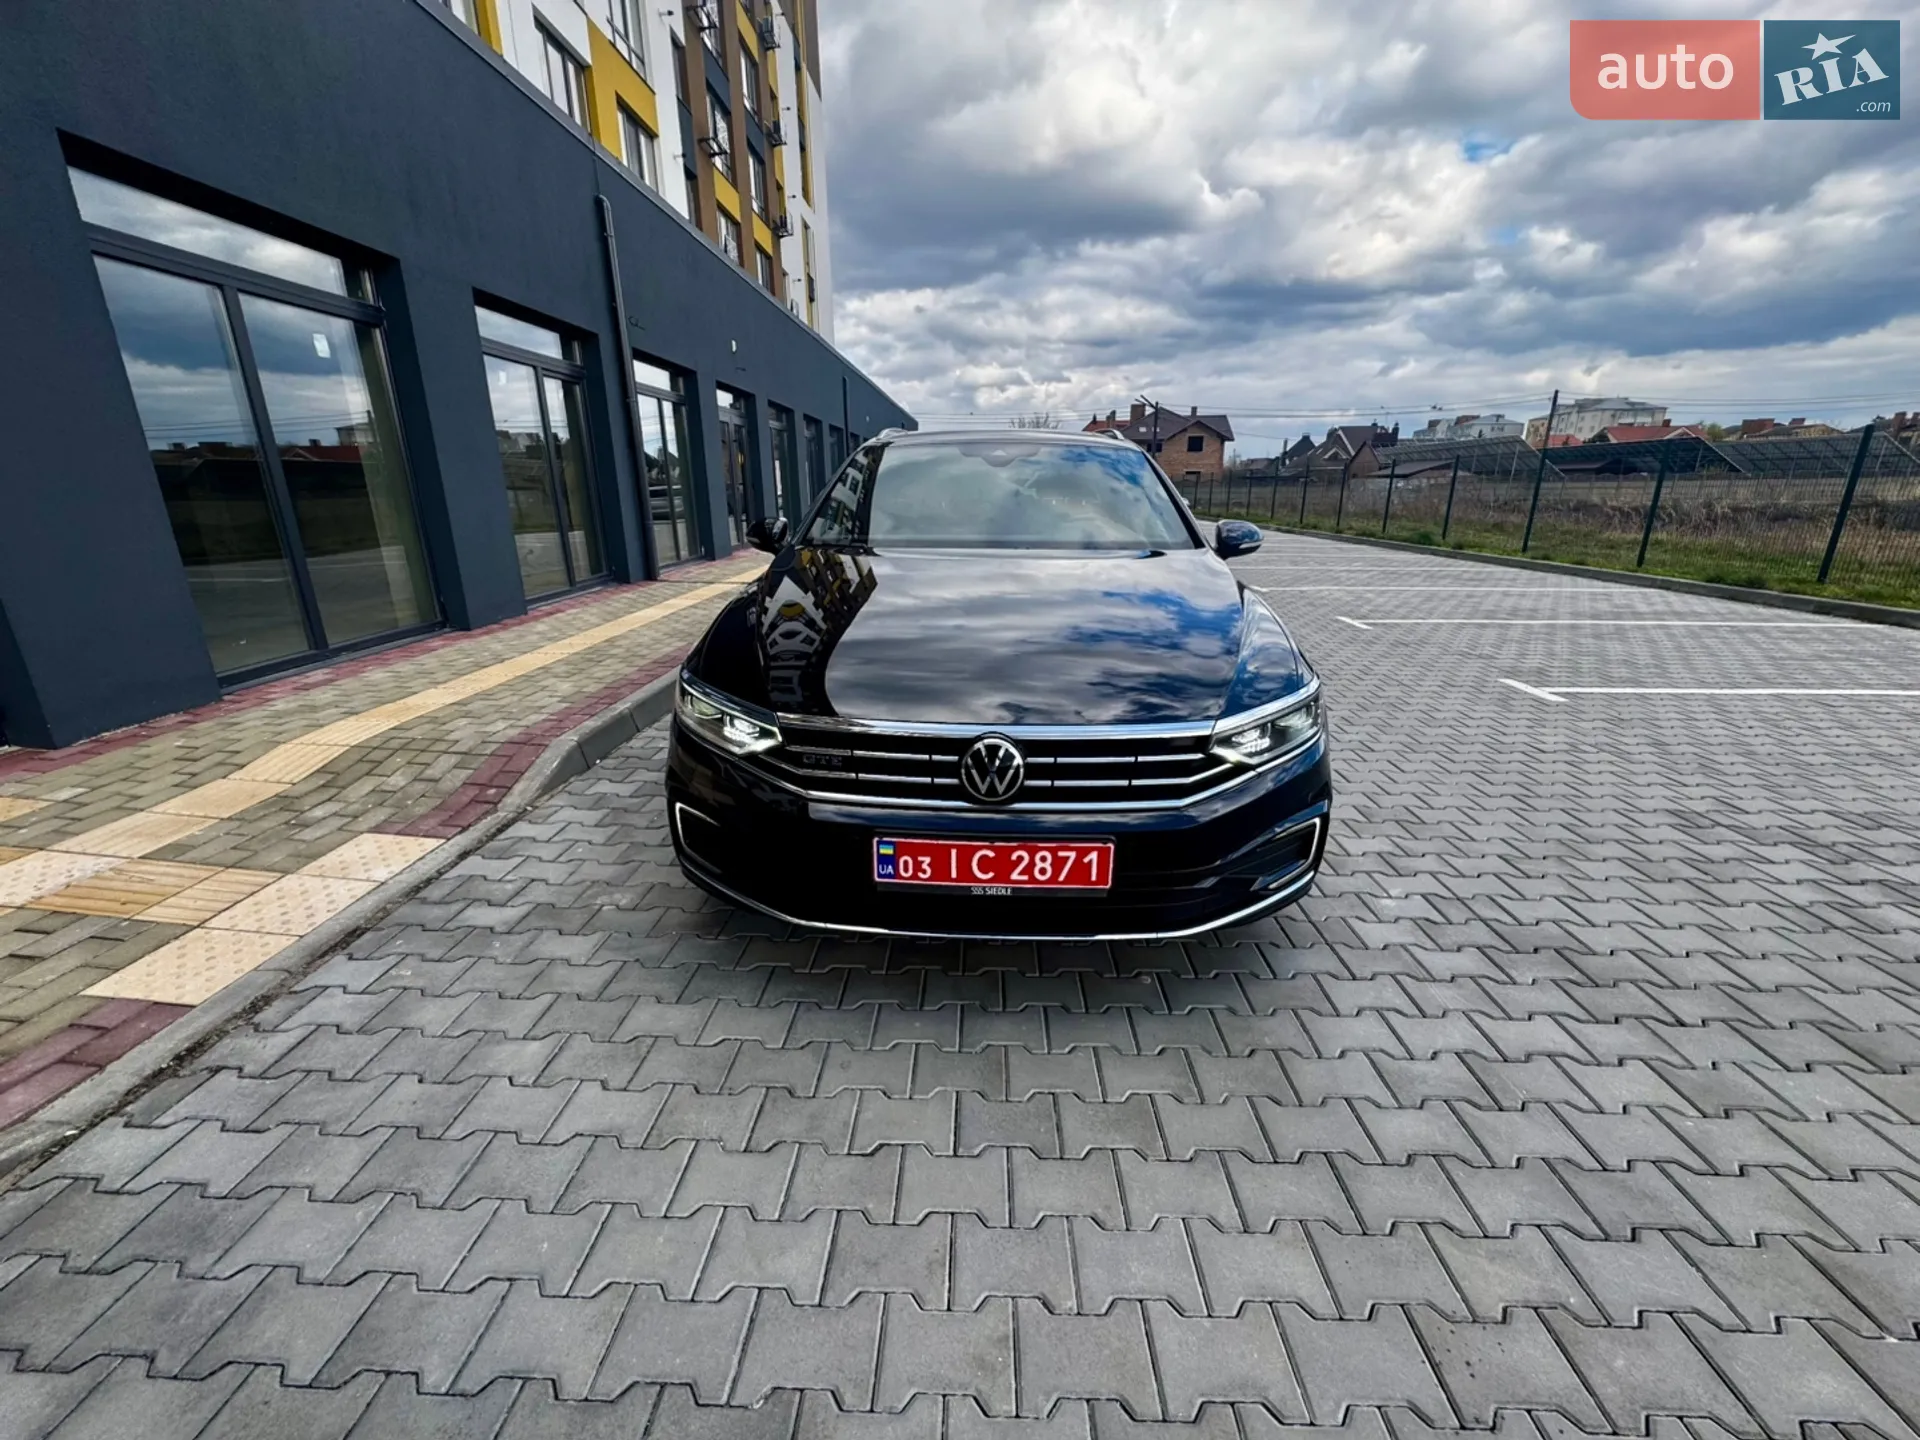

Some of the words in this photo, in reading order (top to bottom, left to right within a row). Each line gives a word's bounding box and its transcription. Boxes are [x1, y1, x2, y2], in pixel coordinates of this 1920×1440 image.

[803, 754, 842, 767] GTE
[879, 864, 894, 875] UA
[899, 855, 932, 879] 03
[1010, 850, 1099, 881] 2871
[985, 887, 1013, 895] SIEDLE
